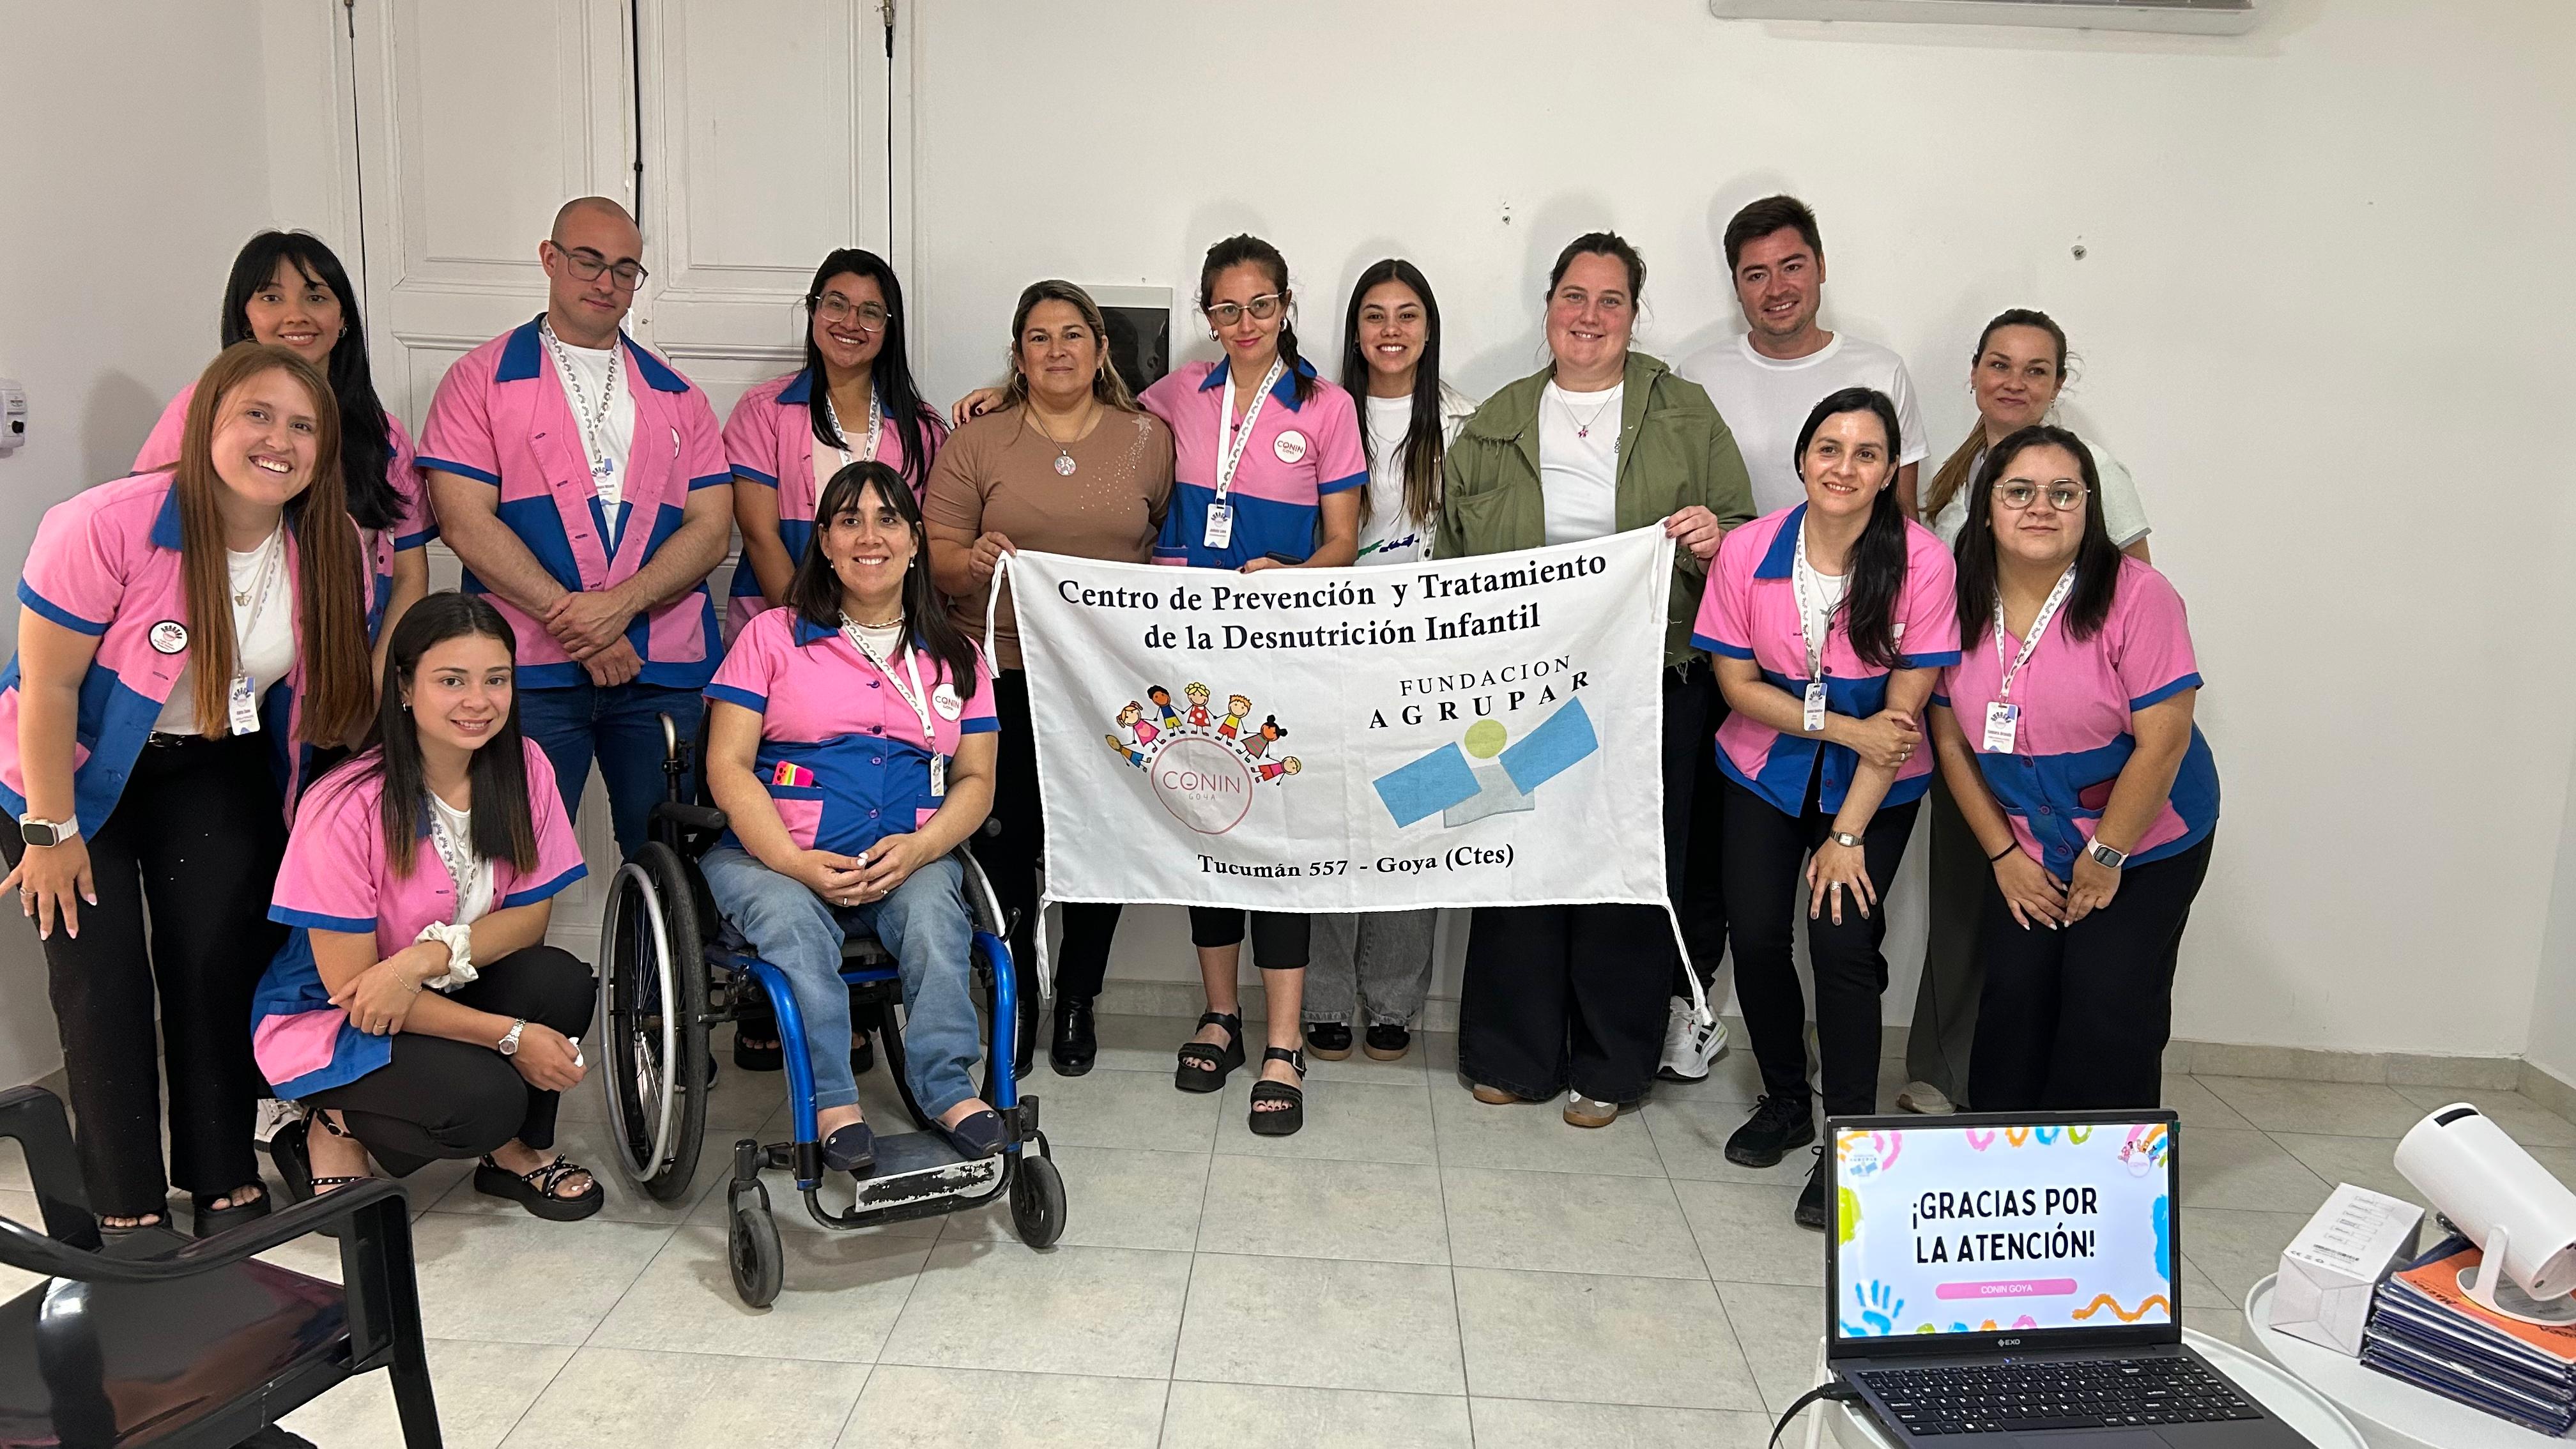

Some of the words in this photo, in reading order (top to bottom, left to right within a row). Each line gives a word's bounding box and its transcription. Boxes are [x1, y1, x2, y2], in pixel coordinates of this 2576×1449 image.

[1276, 440, 1303, 454] CONIN
[1058, 579, 1159, 610] Centro
[1170, 586, 1202, 610] de
[1211, 581, 1376, 611] Prevención
[1392, 583, 1408, 608] y
[1418, 555, 1607, 599] Tratamiento
[1144, 624, 1176, 649] de
[1185, 625, 1213, 650] la
[1222, 620, 1416, 650] Desnutrición
[1425, 602, 1540, 641] Infantil
[1399, 655, 1570, 696] FUNDACION
[1368, 671, 1590, 729] AGRUPAR
[1163, 770, 1241, 793] CONIN
[1188, 793, 1216, 802] GOYA
[1197, 854, 1302, 878] Tucumán
[1309, 859, 1349, 877] 557
[1376, 857, 1438, 875] Goya
[1445, 843, 1515, 871] (Ctes)
[1913, 1188, 2036, 1229] ¡GRACIAS
[2045, 1187, 2098, 1216] POR
[1917, 1236, 1948, 1264] LA
[1957, 1222, 2095, 1262] ATENCIÓN!
[1981, 1285, 2007, 1294] CONIN
[2009, 1284, 2033, 1293] GOYA
